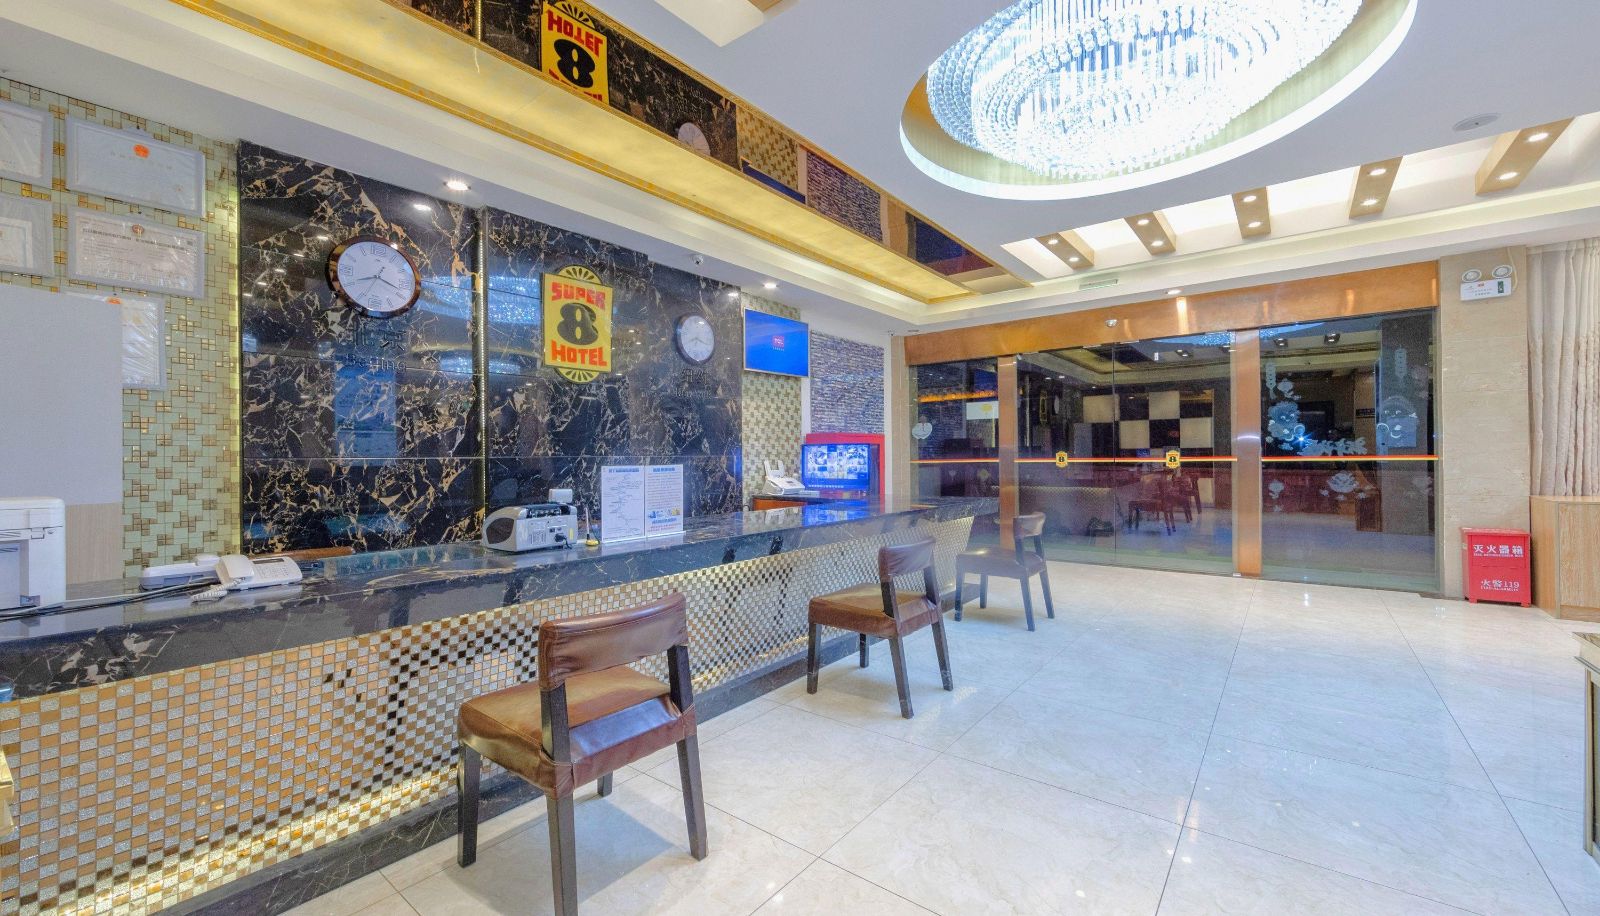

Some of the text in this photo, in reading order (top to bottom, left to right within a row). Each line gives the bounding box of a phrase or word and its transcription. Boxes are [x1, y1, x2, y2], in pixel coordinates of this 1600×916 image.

[551, 281, 605, 311] SUPER
[557, 302, 598, 345] 8
[551, 340, 607, 366] HOTEL
